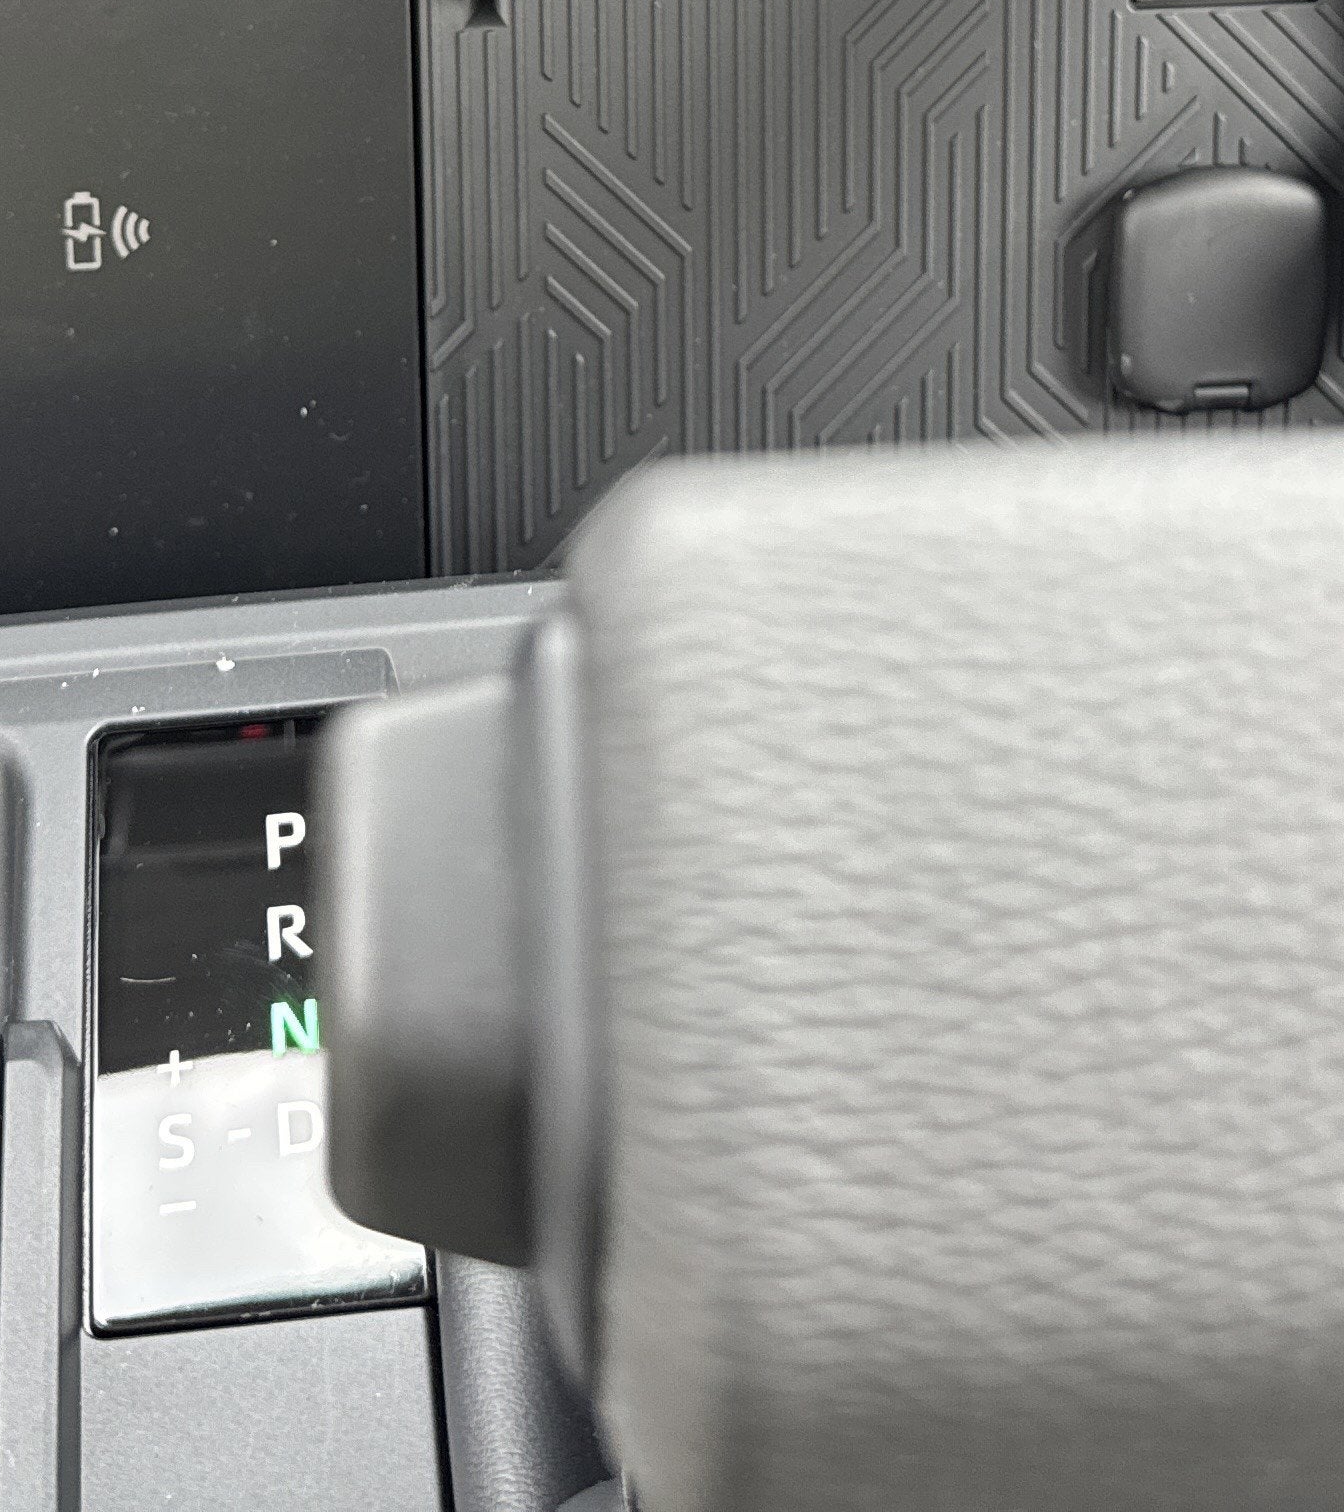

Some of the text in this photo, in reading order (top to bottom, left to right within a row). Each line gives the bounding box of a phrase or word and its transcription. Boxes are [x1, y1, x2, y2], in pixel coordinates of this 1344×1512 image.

[266, 812, 306, 870] P
[267, 904, 314, 963] R
[271, 998, 320, 1058] N
[159, 1113, 196, 1169] S
[277, 1100, 323, 1157] D
